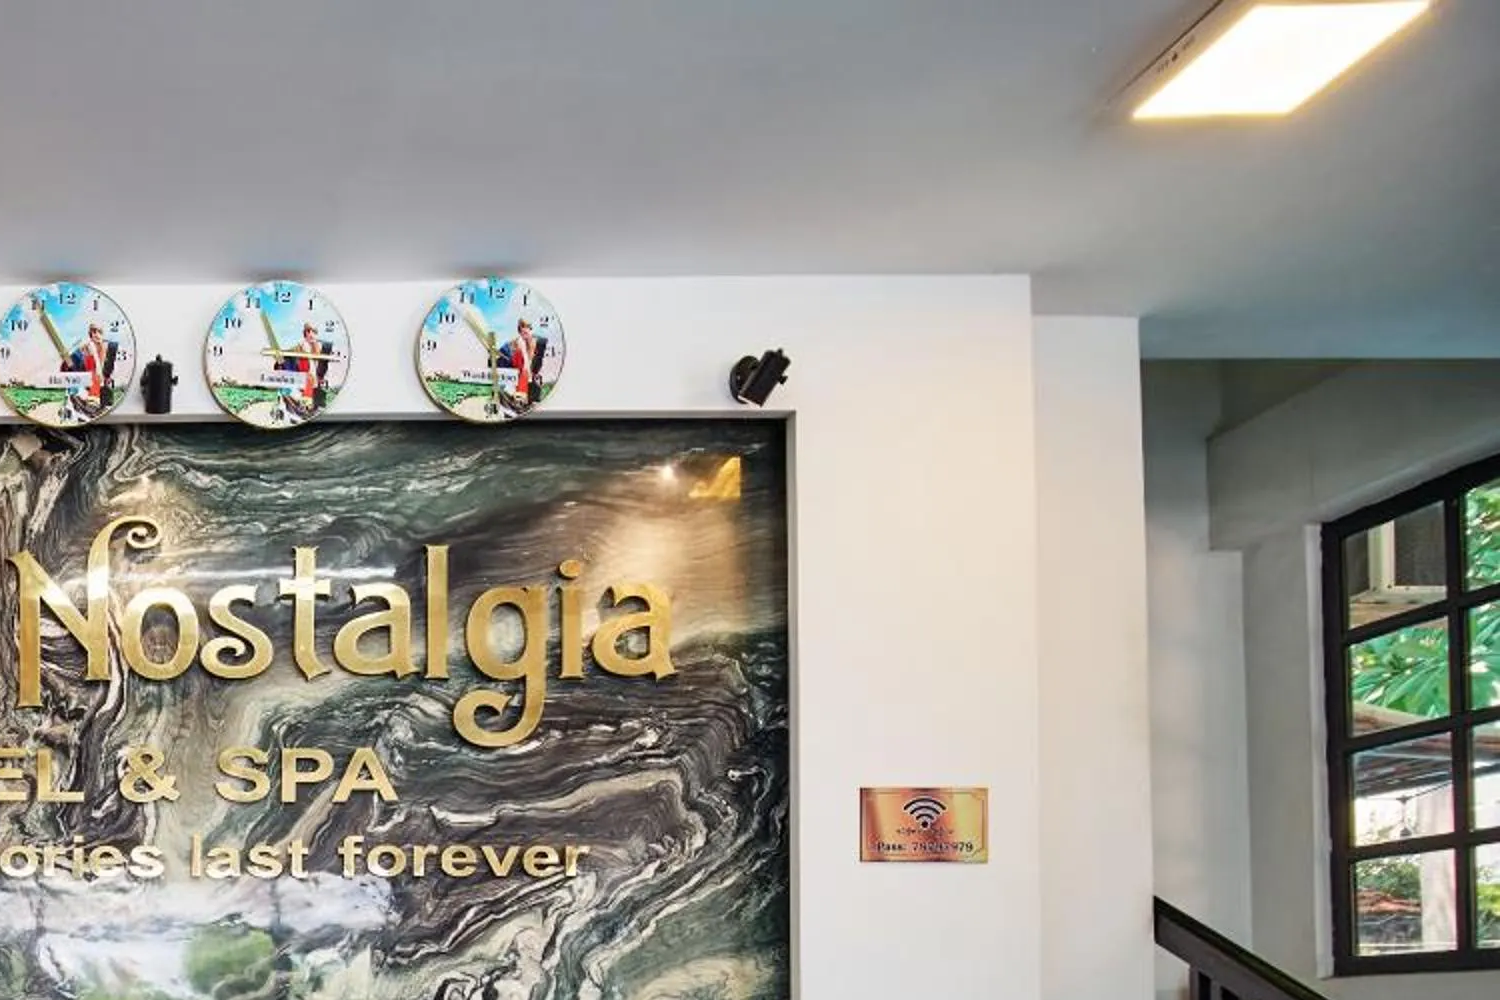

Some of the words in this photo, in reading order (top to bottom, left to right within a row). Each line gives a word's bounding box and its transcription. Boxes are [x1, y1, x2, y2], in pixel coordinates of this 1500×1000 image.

[6, 514, 679, 747] Nostalgia
[118, 746, 180, 802] &
[214, 746, 400, 803] SPA
[189, 833, 309, 879] last
[338, 834, 591, 880] forever
